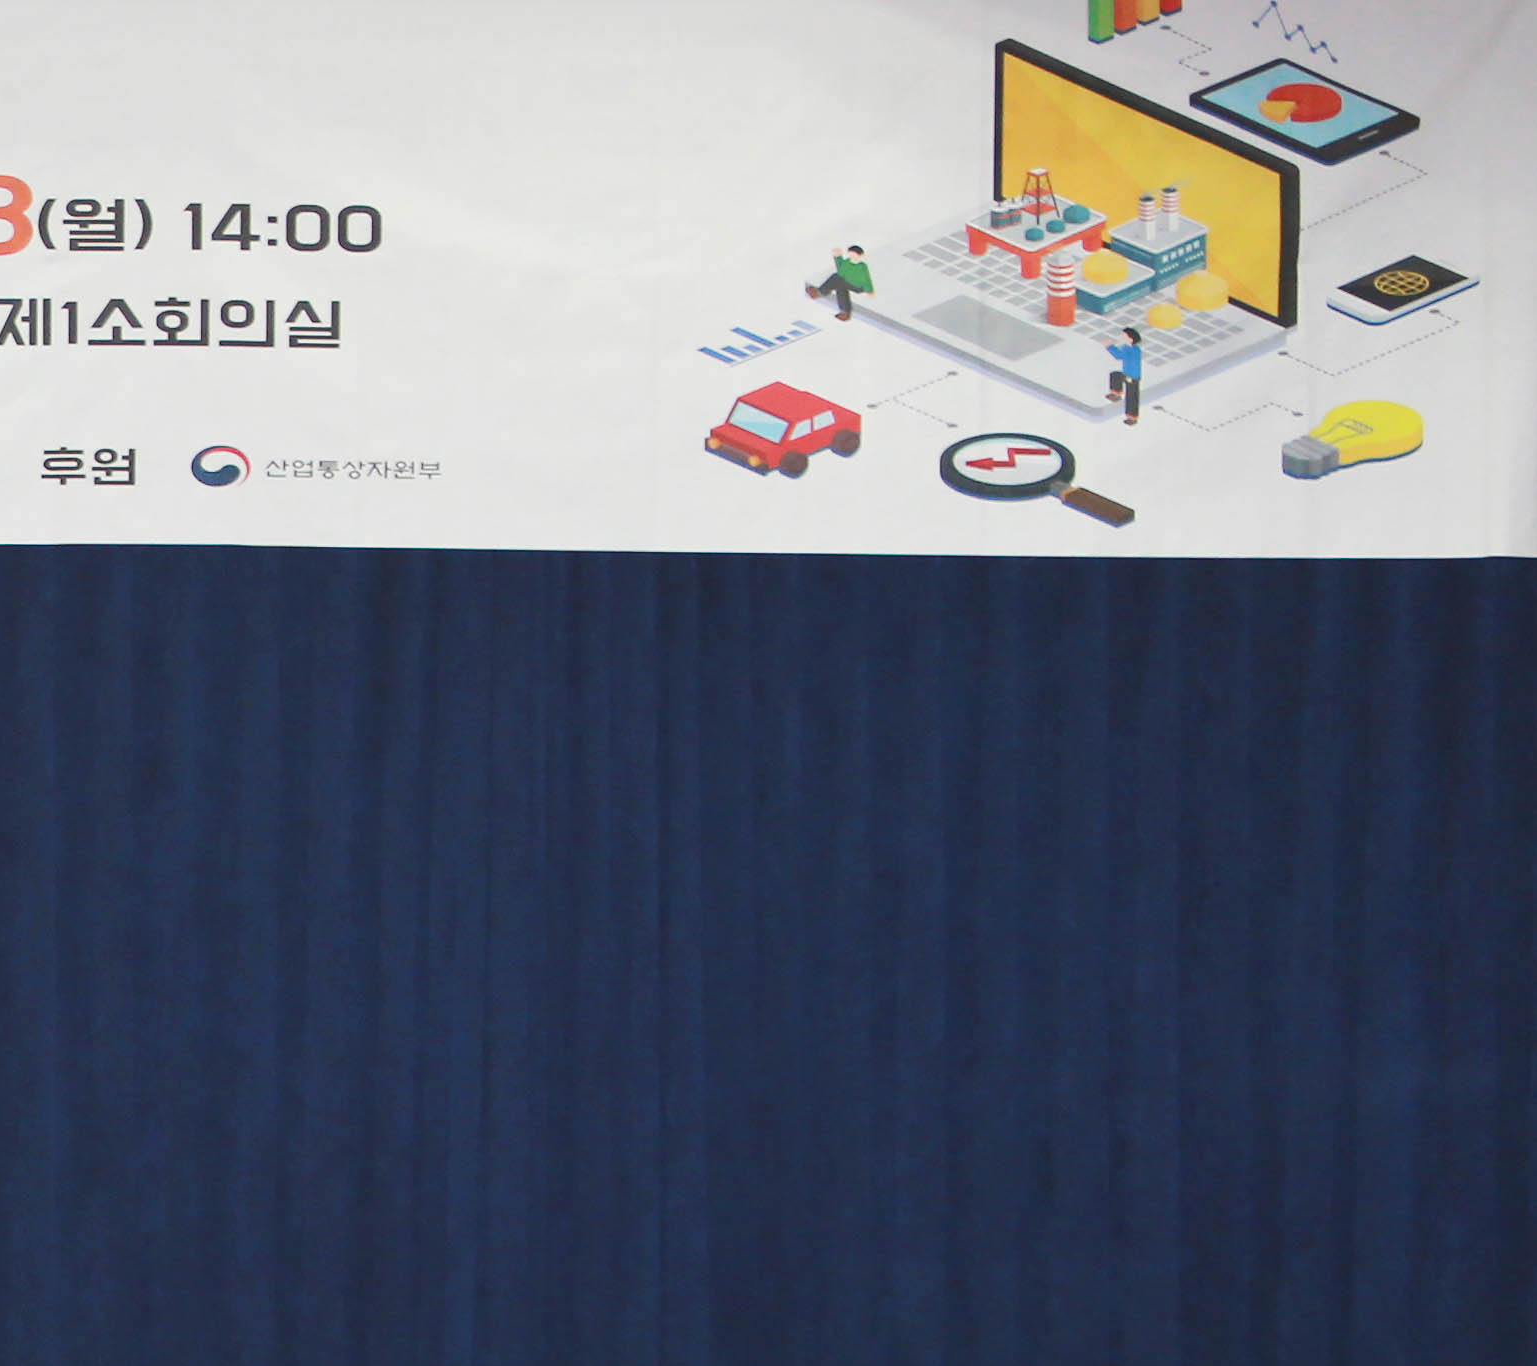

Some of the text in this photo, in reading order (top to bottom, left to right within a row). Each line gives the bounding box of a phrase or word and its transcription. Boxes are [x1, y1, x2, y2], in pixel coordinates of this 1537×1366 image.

[183, 202, 382, 253] 14:00
[40, 446, 136, 486] 후원
[265, 459, 442, 480] 산업통상자원부
